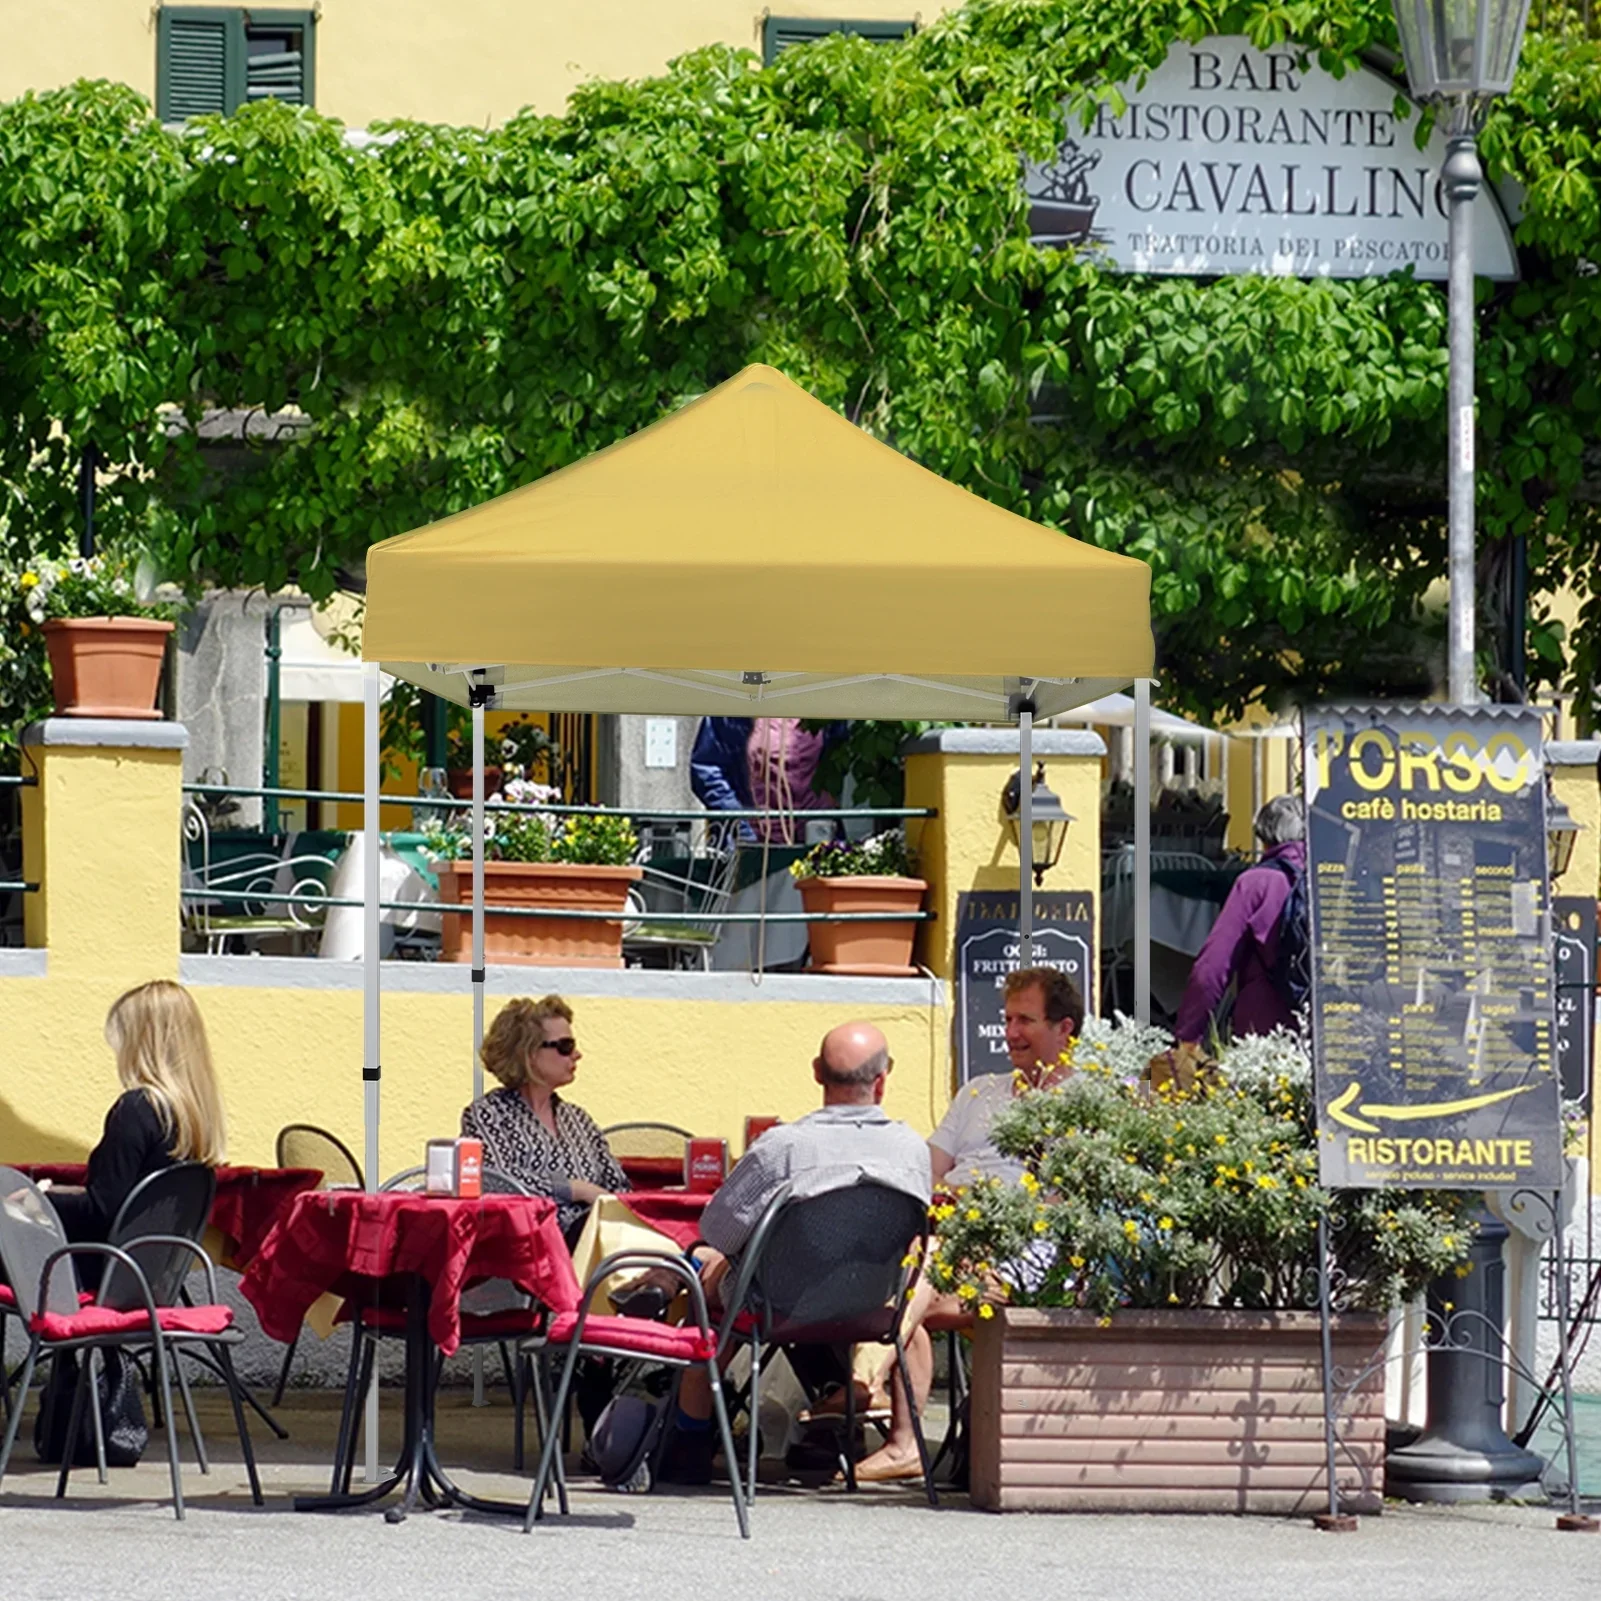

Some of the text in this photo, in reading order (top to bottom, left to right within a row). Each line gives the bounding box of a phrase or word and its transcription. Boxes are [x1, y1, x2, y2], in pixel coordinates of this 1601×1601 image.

[1190, 52, 1301, 92] BAR
[1093, 102, 1395, 148] RISTORANTE
[1127, 232, 1265, 257] TRATTORIA
[1278, 236, 1321, 258] DEI
[1341, 797, 1503, 822] cafè hostaria
[1347, 1137, 1533, 1166] RISTORANTE
